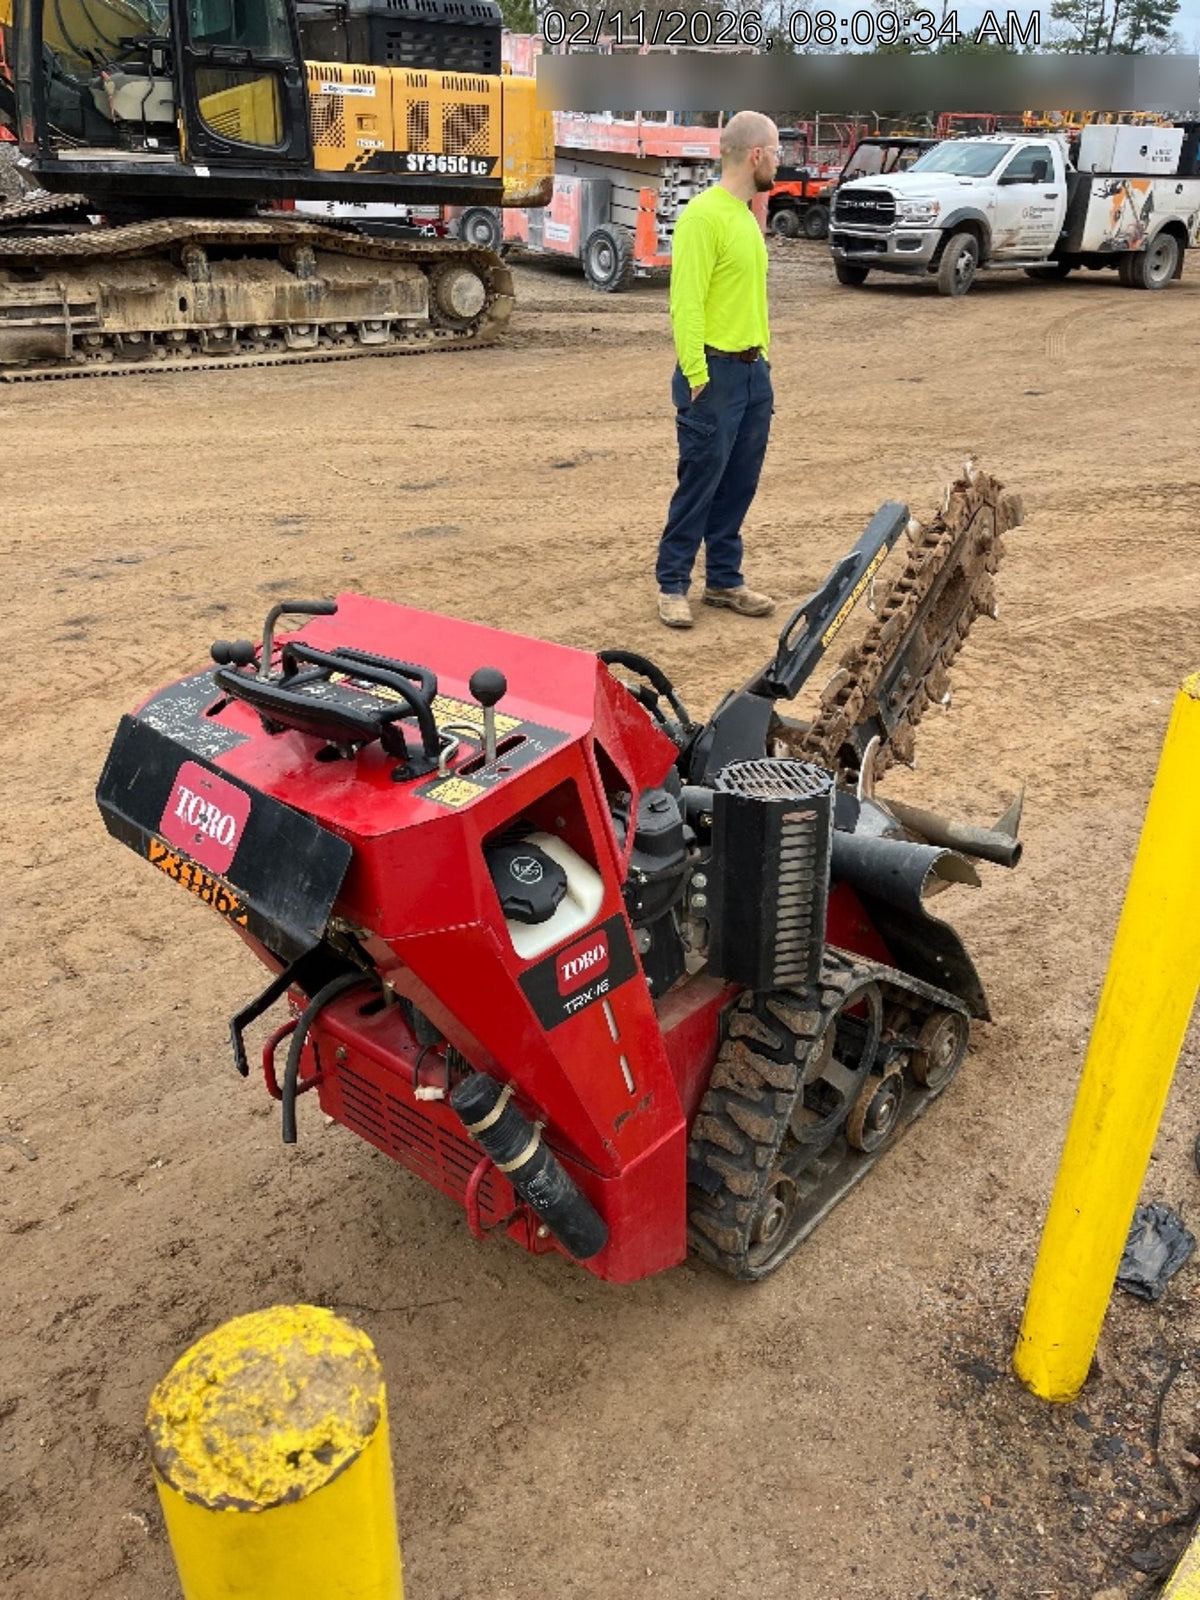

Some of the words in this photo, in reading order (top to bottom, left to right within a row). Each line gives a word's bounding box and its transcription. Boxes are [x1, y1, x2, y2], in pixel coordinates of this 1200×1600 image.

[406, 153, 469, 174] SY365C
[470, 160, 488, 175] LC
[173, 785, 236, 846] TORO
[561, 944, 607, 981] TORO
